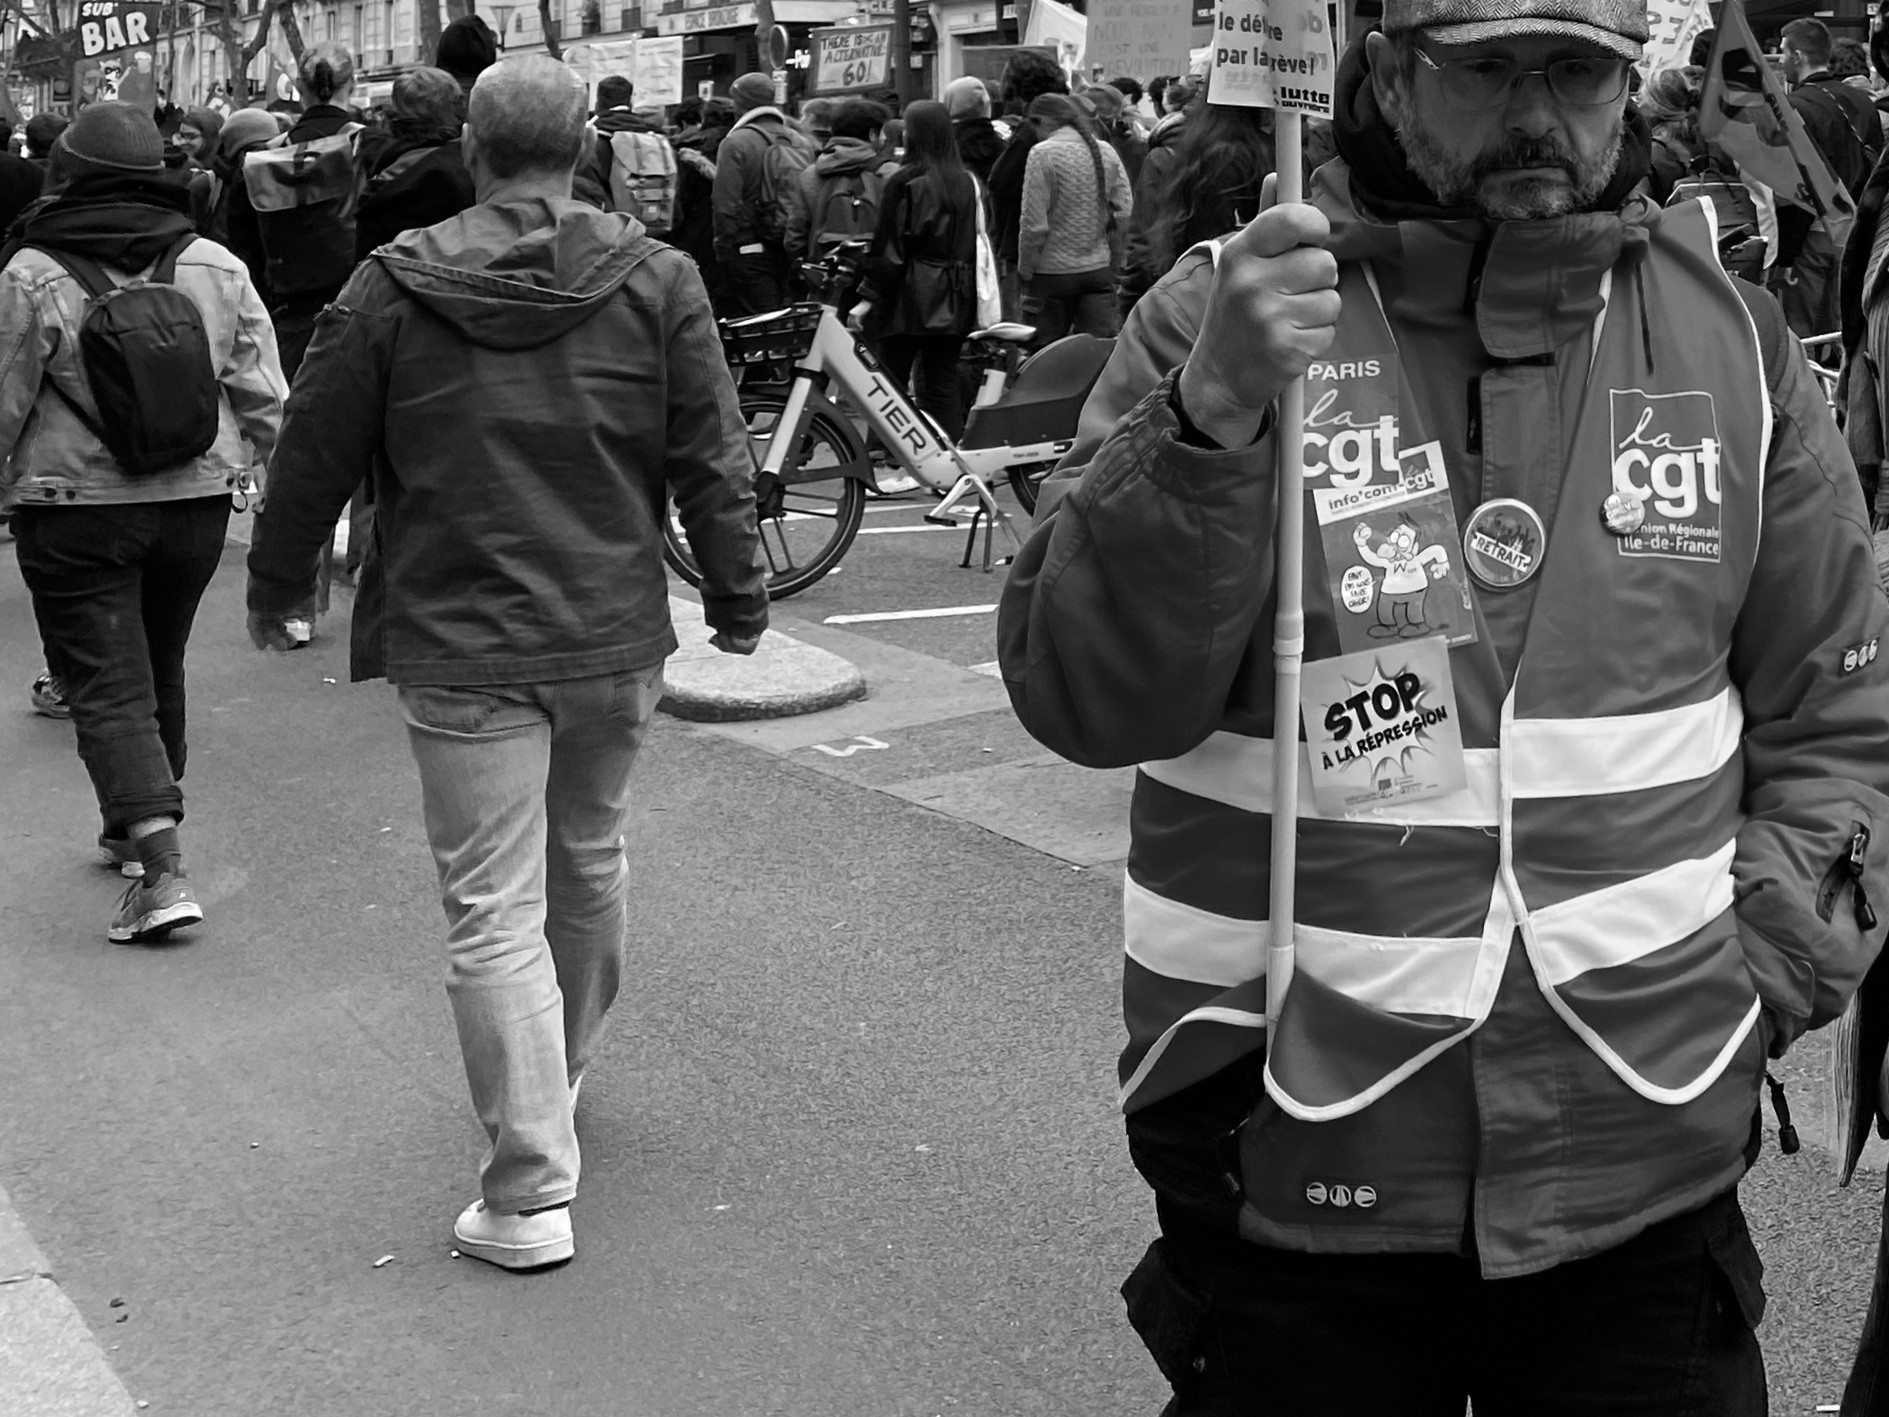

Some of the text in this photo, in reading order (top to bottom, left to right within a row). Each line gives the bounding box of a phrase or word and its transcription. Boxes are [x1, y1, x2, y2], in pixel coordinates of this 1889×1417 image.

[81, 11, 150, 56] BAR
[1219, 11, 1235, 31] le
[1217, 48, 1248, 68] par
[1254, 47, 1269, 66] la
[1281, 87, 1330, 105] lutte
[1307, 360, 1381, 380] PARIS
[867, 375, 926, 456] TIER
[1303, 415, 1400, 488] cgt
[1614, 438, 1721, 519] cgt
[1637, 522, 1720, 539] nion Régionale
[1475, 536, 1526, 568] RETRAIT
[1324, 672, 1421, 741] STOP
[1322, 705, 1448, 770] À LA RÉPRESSION
